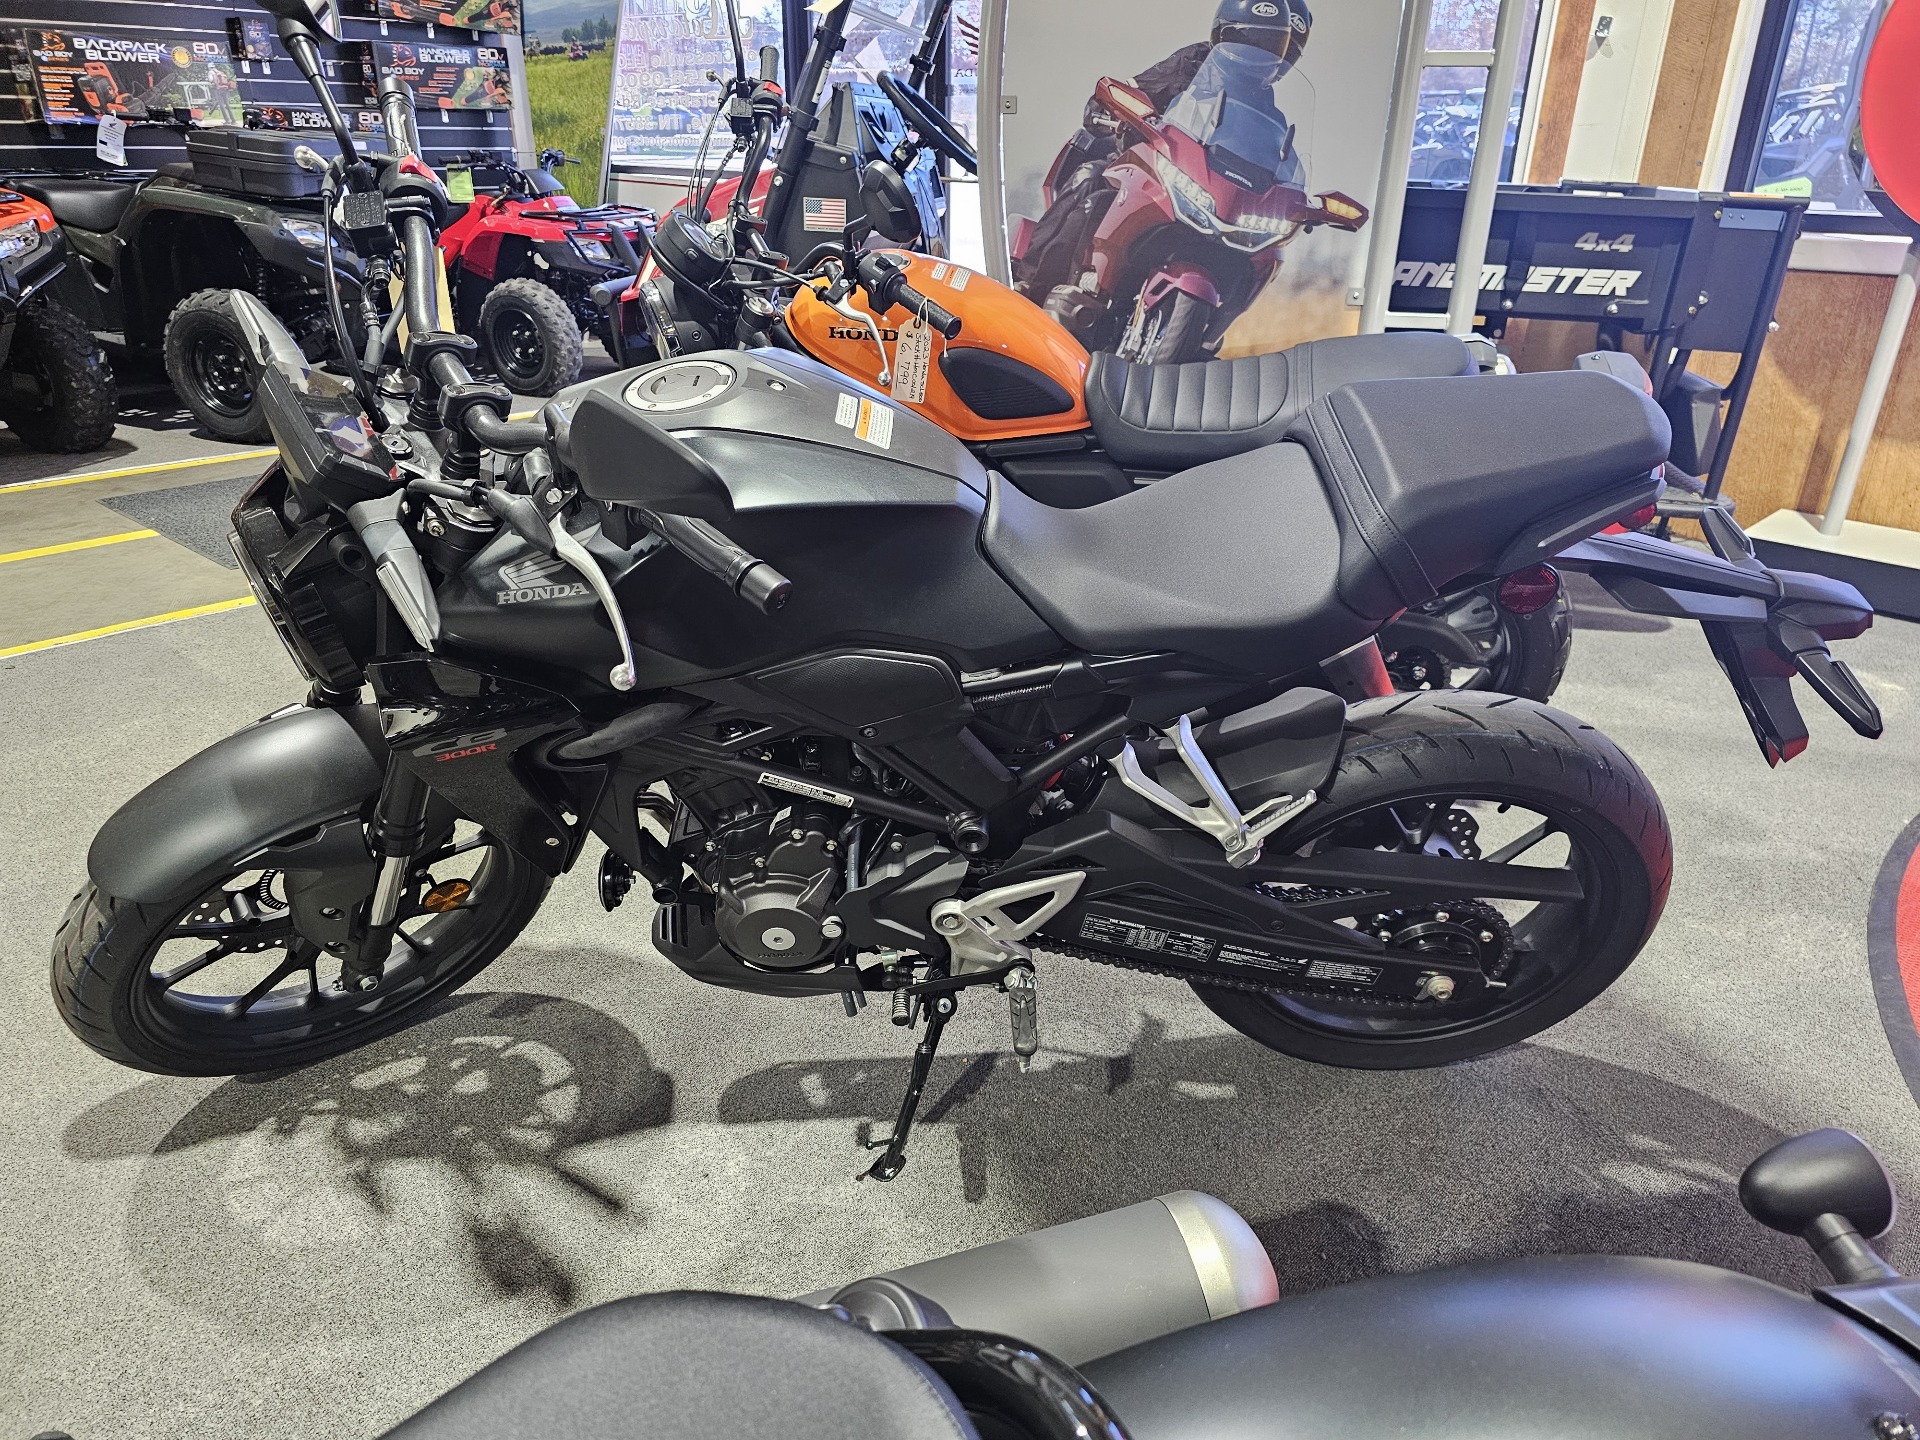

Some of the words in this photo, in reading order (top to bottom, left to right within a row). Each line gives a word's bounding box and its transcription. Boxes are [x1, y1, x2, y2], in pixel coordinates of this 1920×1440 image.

[73, 37, 167, 54] BACKPACK
[85, 50, 161, 64] BLOWER
[420, 54, 471, 65] BLOWER
[381, 66, 403, 75] BAD
[404, 67, 425, 76] BOY
[1574, 231, 1636, 253] 4x4
[828, 326, 899, 342] HOND
[922, 333, 931, 360] 2023
[497, 582, 590, 606] HONDA
[434, 743, 497, 762] 300R
